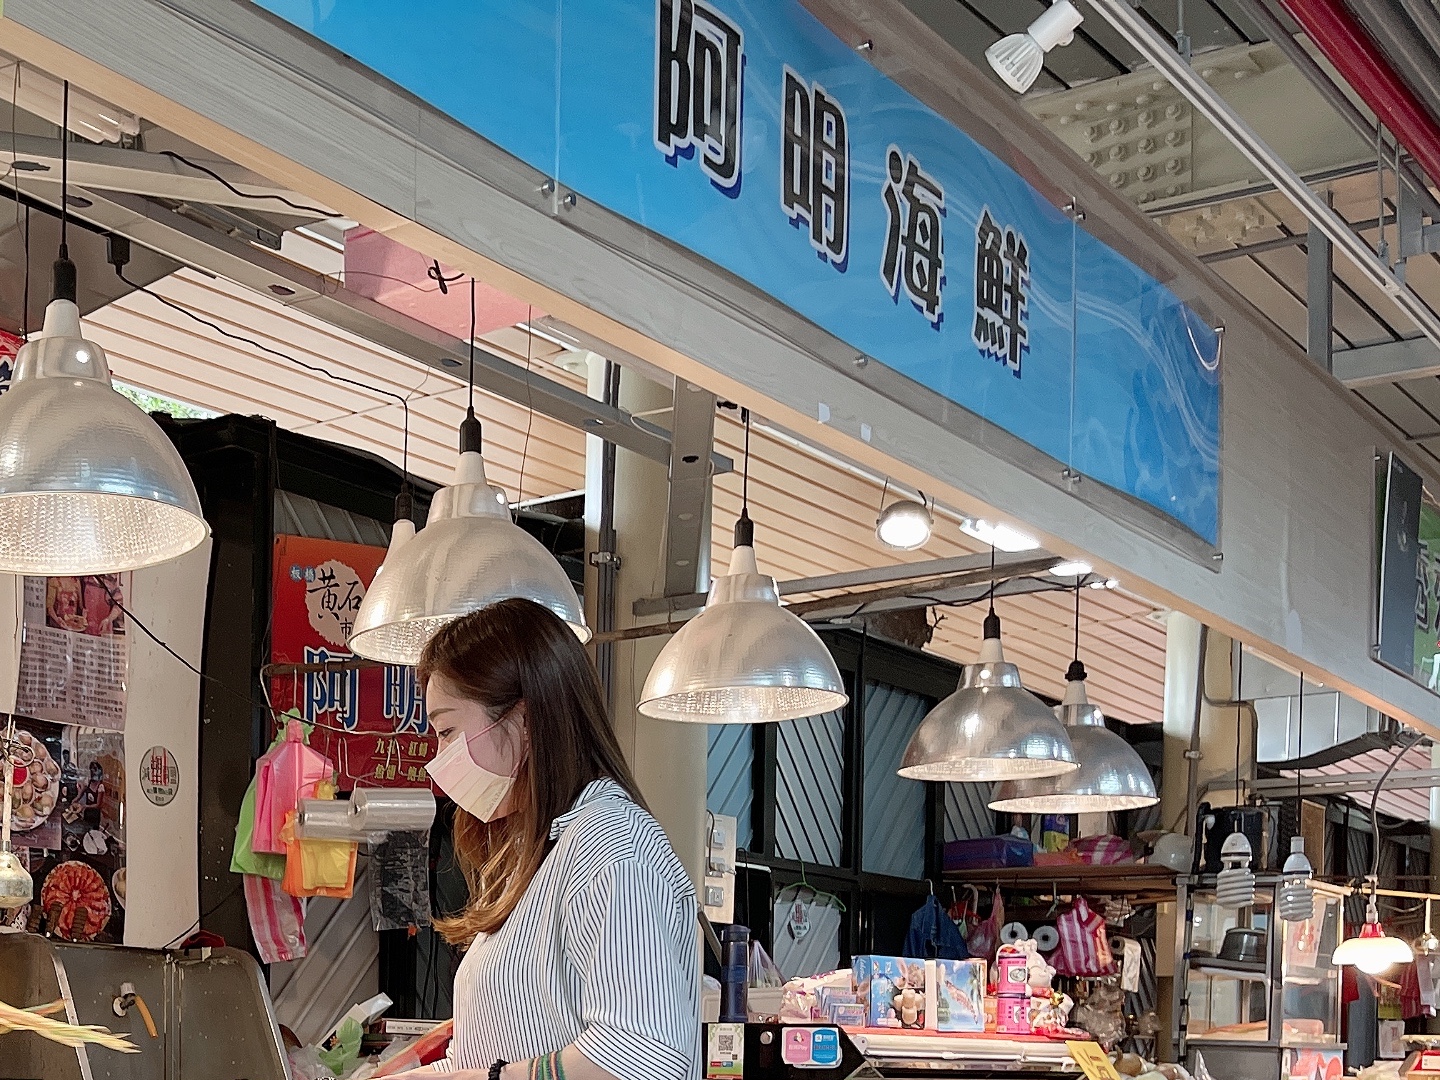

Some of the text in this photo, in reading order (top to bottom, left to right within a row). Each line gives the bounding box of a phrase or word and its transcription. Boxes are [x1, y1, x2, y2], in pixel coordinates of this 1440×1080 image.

[655, 0, 1030, 373] 阿明海鮮
[306, 567, 363, 621] 黃石
